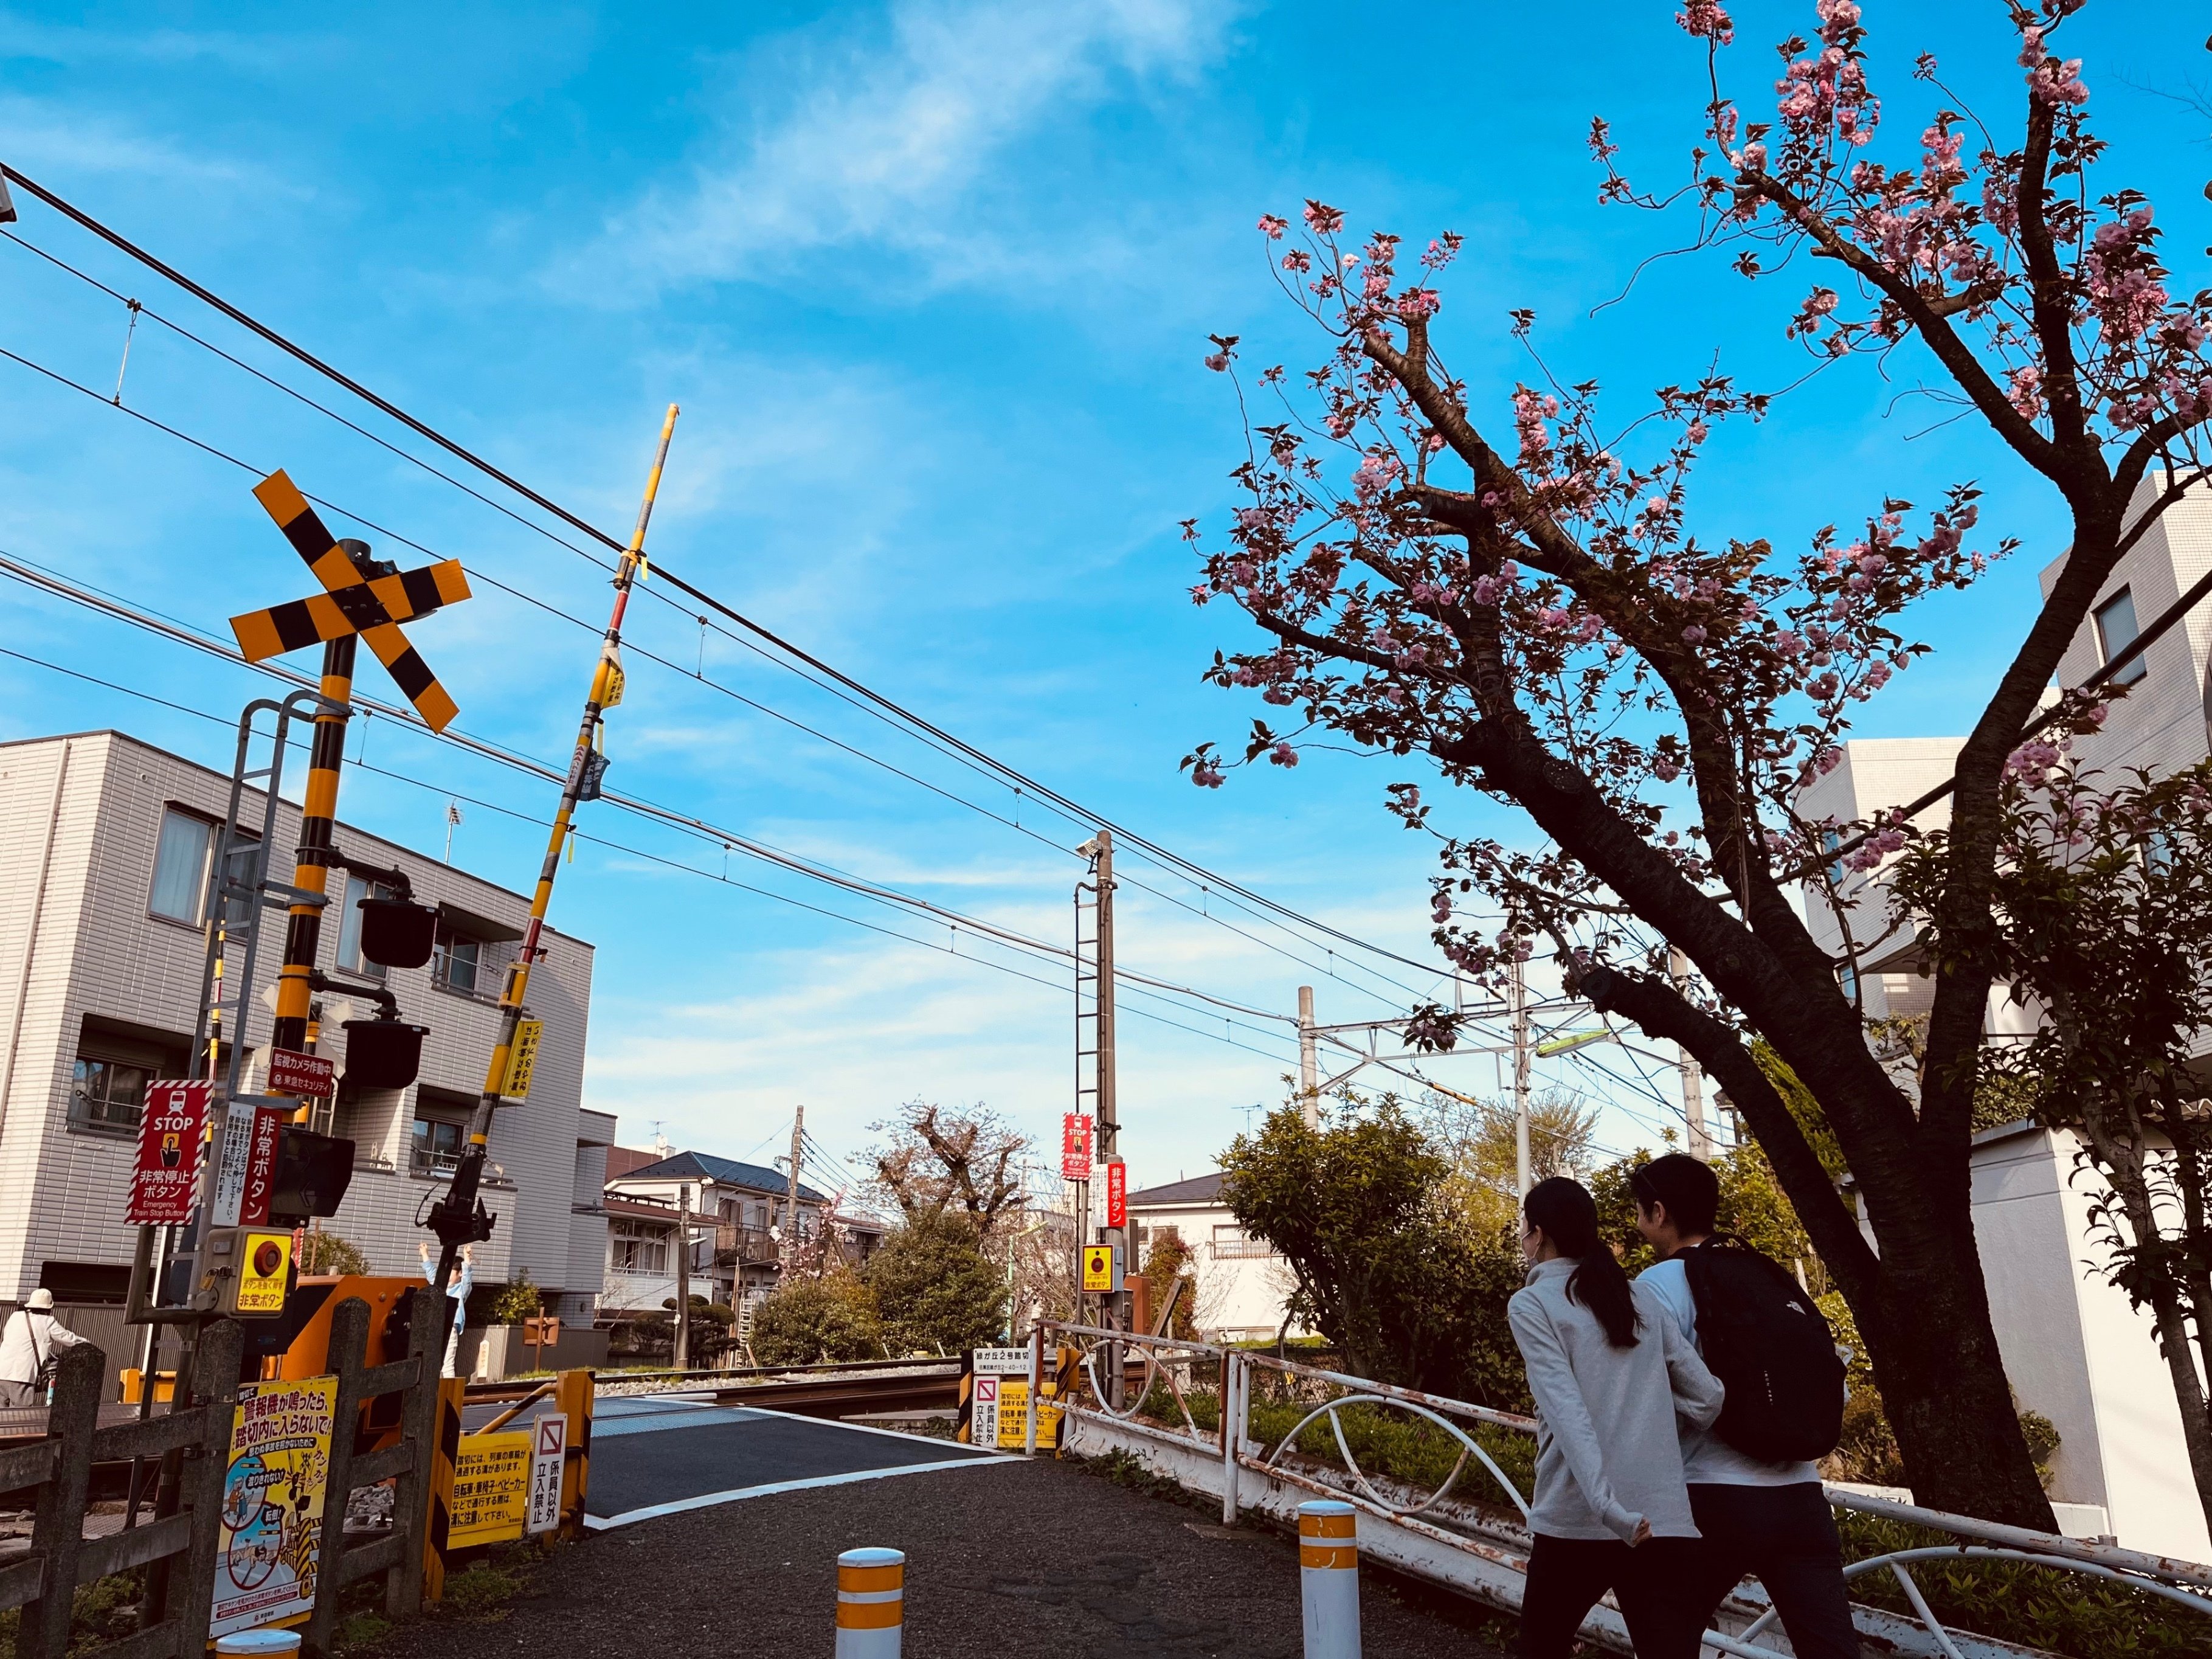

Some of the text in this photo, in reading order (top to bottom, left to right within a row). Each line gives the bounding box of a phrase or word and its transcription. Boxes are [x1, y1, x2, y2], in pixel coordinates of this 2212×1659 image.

[274, 1053, 331, 1076] 監視カメラ作動中
[519, 1025, 541, 1091] おやめ下さい
[284, 1075, 328, 1092] 東急セキュリティ
[154, 1117, 194, 1131] STOP
[139, 1169, 190, 1184] 非常停止
[247, 1115, 275, 1219] 非常ボタン
[143, 1185, 182, 1198] ボタン
[143, 1200, 178, 1209] Emergency
[1111, 1167, 1122, 1223] 非常ボタン
[150, 1209, 164, 1217] Stop
[239, 1294, 283, 1307] 非常ボタン
[244, 1390, 328, 1423] 警報機が鳴ったら、
[975, 1405, 984, 1443] 立入禁止
[986, 1405, 995, 1443] 係員以外
[533, 1462, 546, 1525] 立入禁止
[545, 1460, 559, 1522] 係員以外
